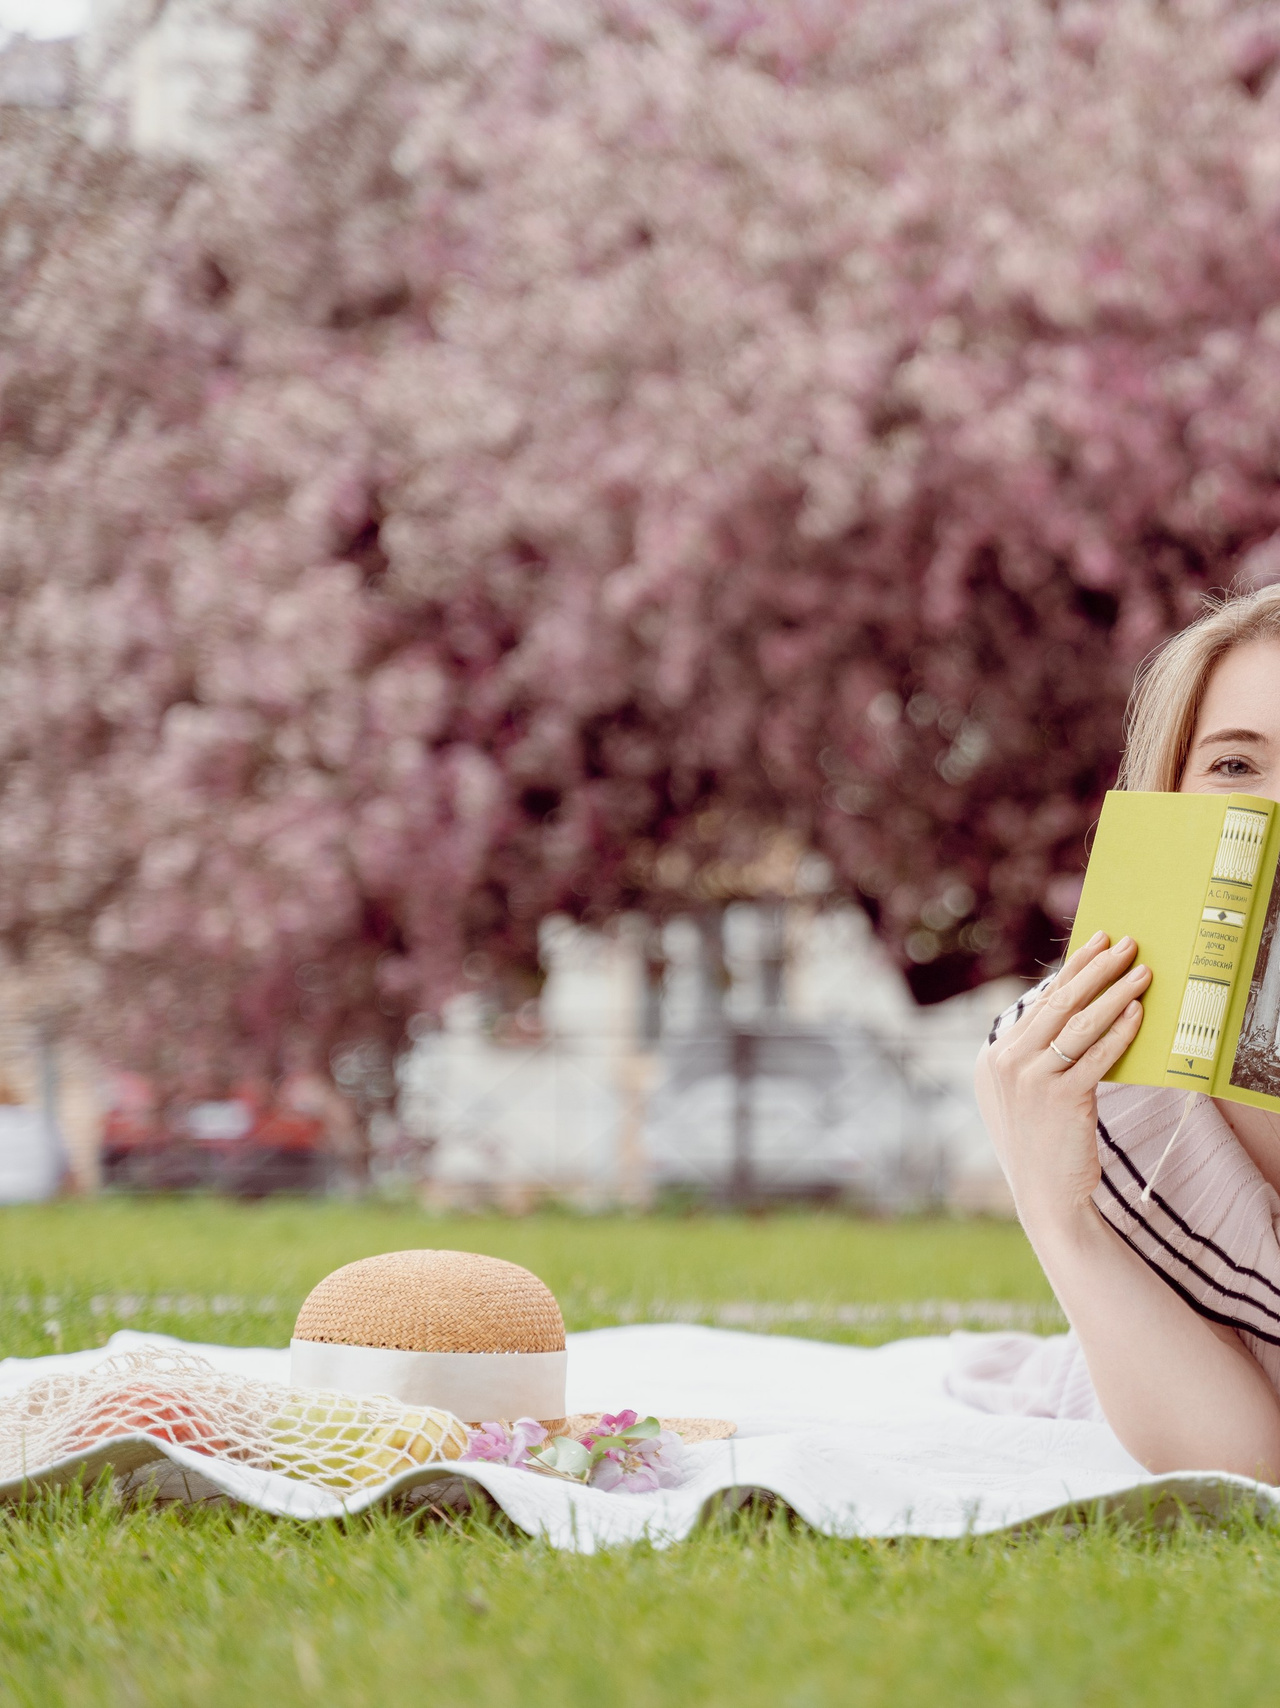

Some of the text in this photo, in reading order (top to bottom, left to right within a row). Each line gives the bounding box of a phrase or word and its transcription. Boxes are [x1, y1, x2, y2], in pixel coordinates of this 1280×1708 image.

[1222, 891, 1248, 903] Пушкин
[1198, 928, 1239, 943] Капитанская
[1205, 941, 1226, 951] дочка
[1192, 954, 1233, 970] Дубровский
